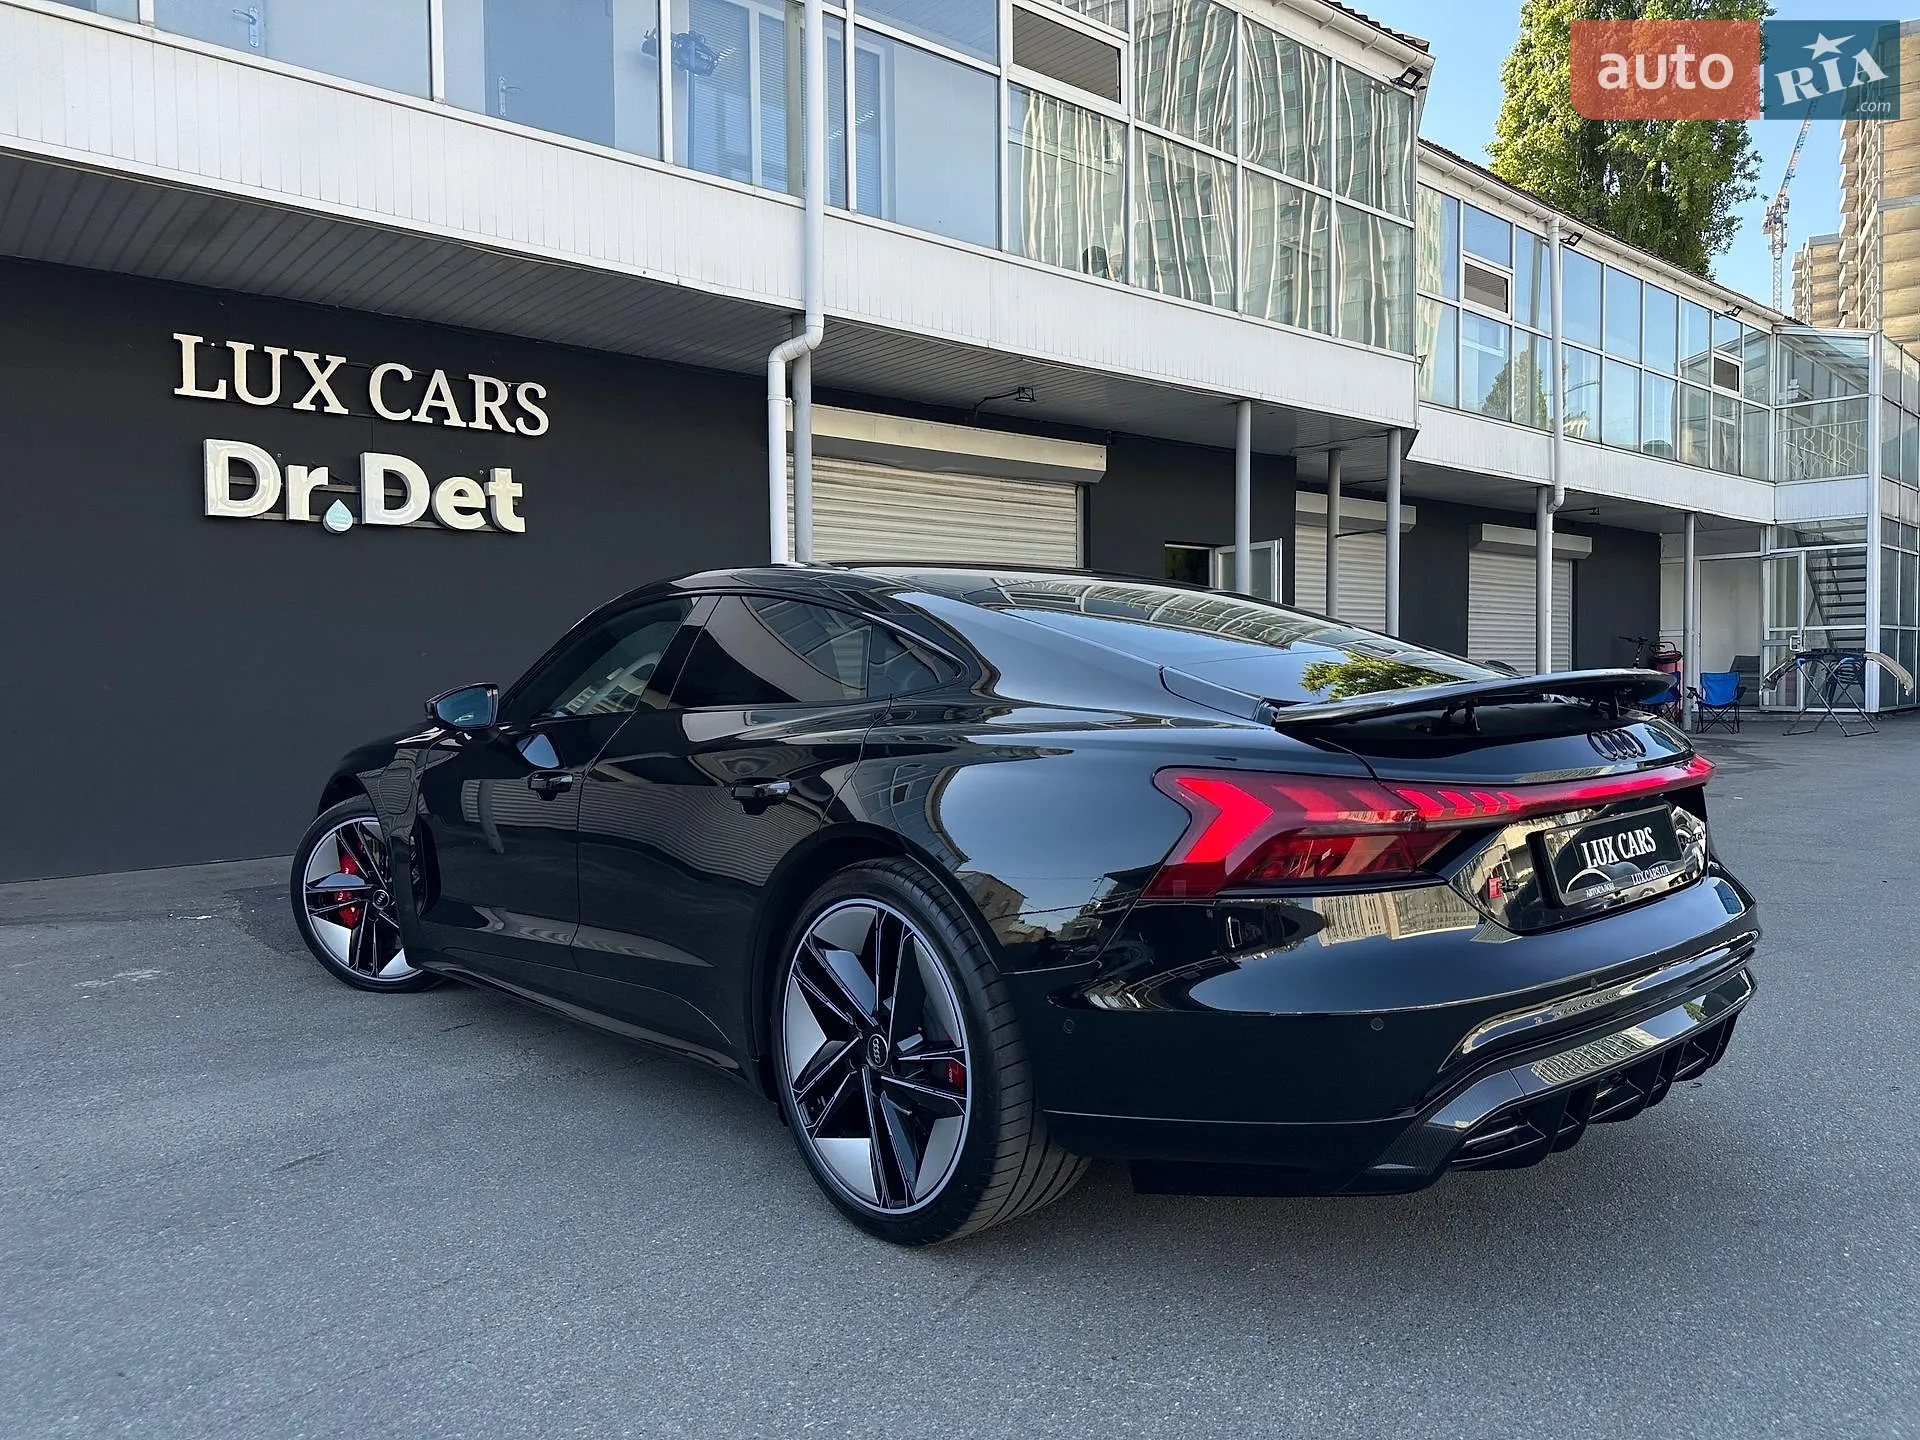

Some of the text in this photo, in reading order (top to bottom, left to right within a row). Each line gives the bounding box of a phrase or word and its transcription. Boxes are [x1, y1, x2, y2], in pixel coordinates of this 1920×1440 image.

[172, 332, 550, 437] LUX CARS
[1580, 826, 1657, 869] LUX CARS
